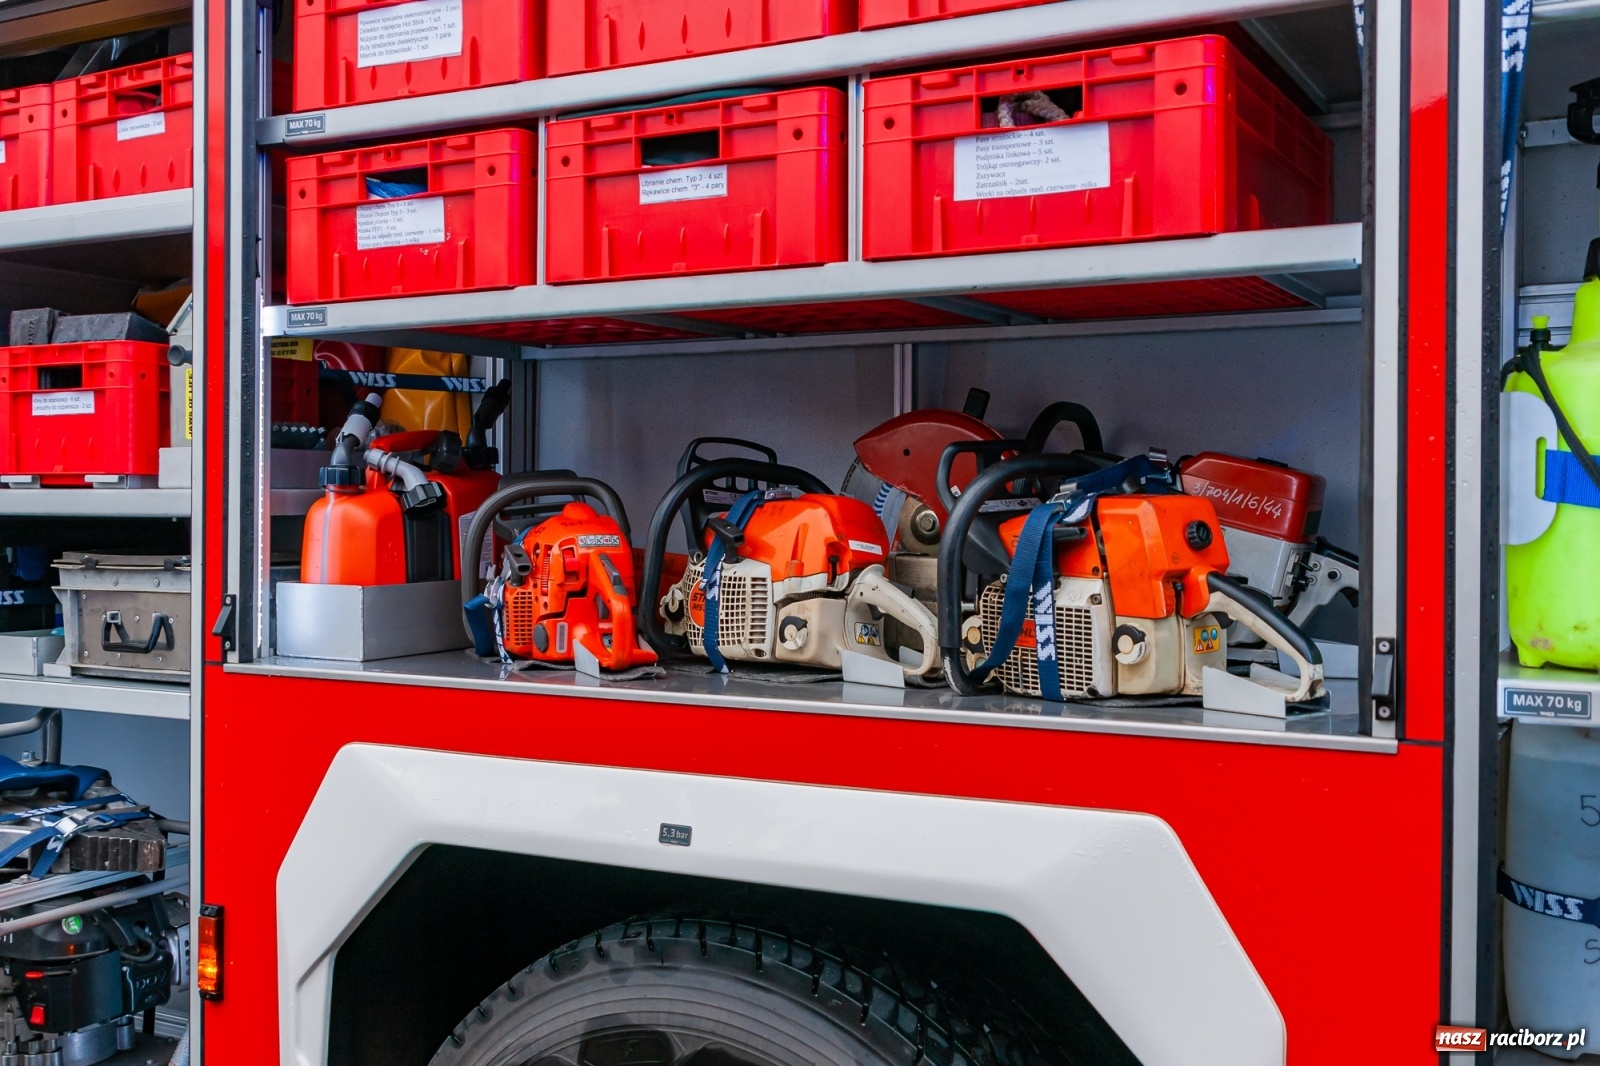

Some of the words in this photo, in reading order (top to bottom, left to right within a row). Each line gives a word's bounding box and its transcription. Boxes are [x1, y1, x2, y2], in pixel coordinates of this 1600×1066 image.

[382, 15, 403, 23] specjalne
[290, 120, 304, 129] MAX
[305, 119, 312, 127] 70
[314, 119, 321, 128] kg
[991, 141, 1031, 151] transportowe
[976, 152, 1004, 162] Podpinka
[976, 162, 998, 171] Trójkąt
[976, 171, 1005, 180] Zszywacz
[642, 179, 664, 187] Ubranie
[666, 176, 683, 185] chem.
[642, 188, 670, 197] Rękawice
[1005, 187, 1027, 196] odpady
[291, 313, 305, 321] MAX
[306, 312, 314, 320] 70
[316, 312, 323, 321] kg
[349, 372, 396, 387] WISS
[1034, 581, 1055, 660] WISS
[1513, 694, 1543, 707] MAX
[1547, 696, 1564, 708] 70
[1567, 697, 1581, 712] kg
[663, 828, 675, 838] 5,3
[676, 830, 688, 839] bar
[1511, 880, 1583, 921] WISS
